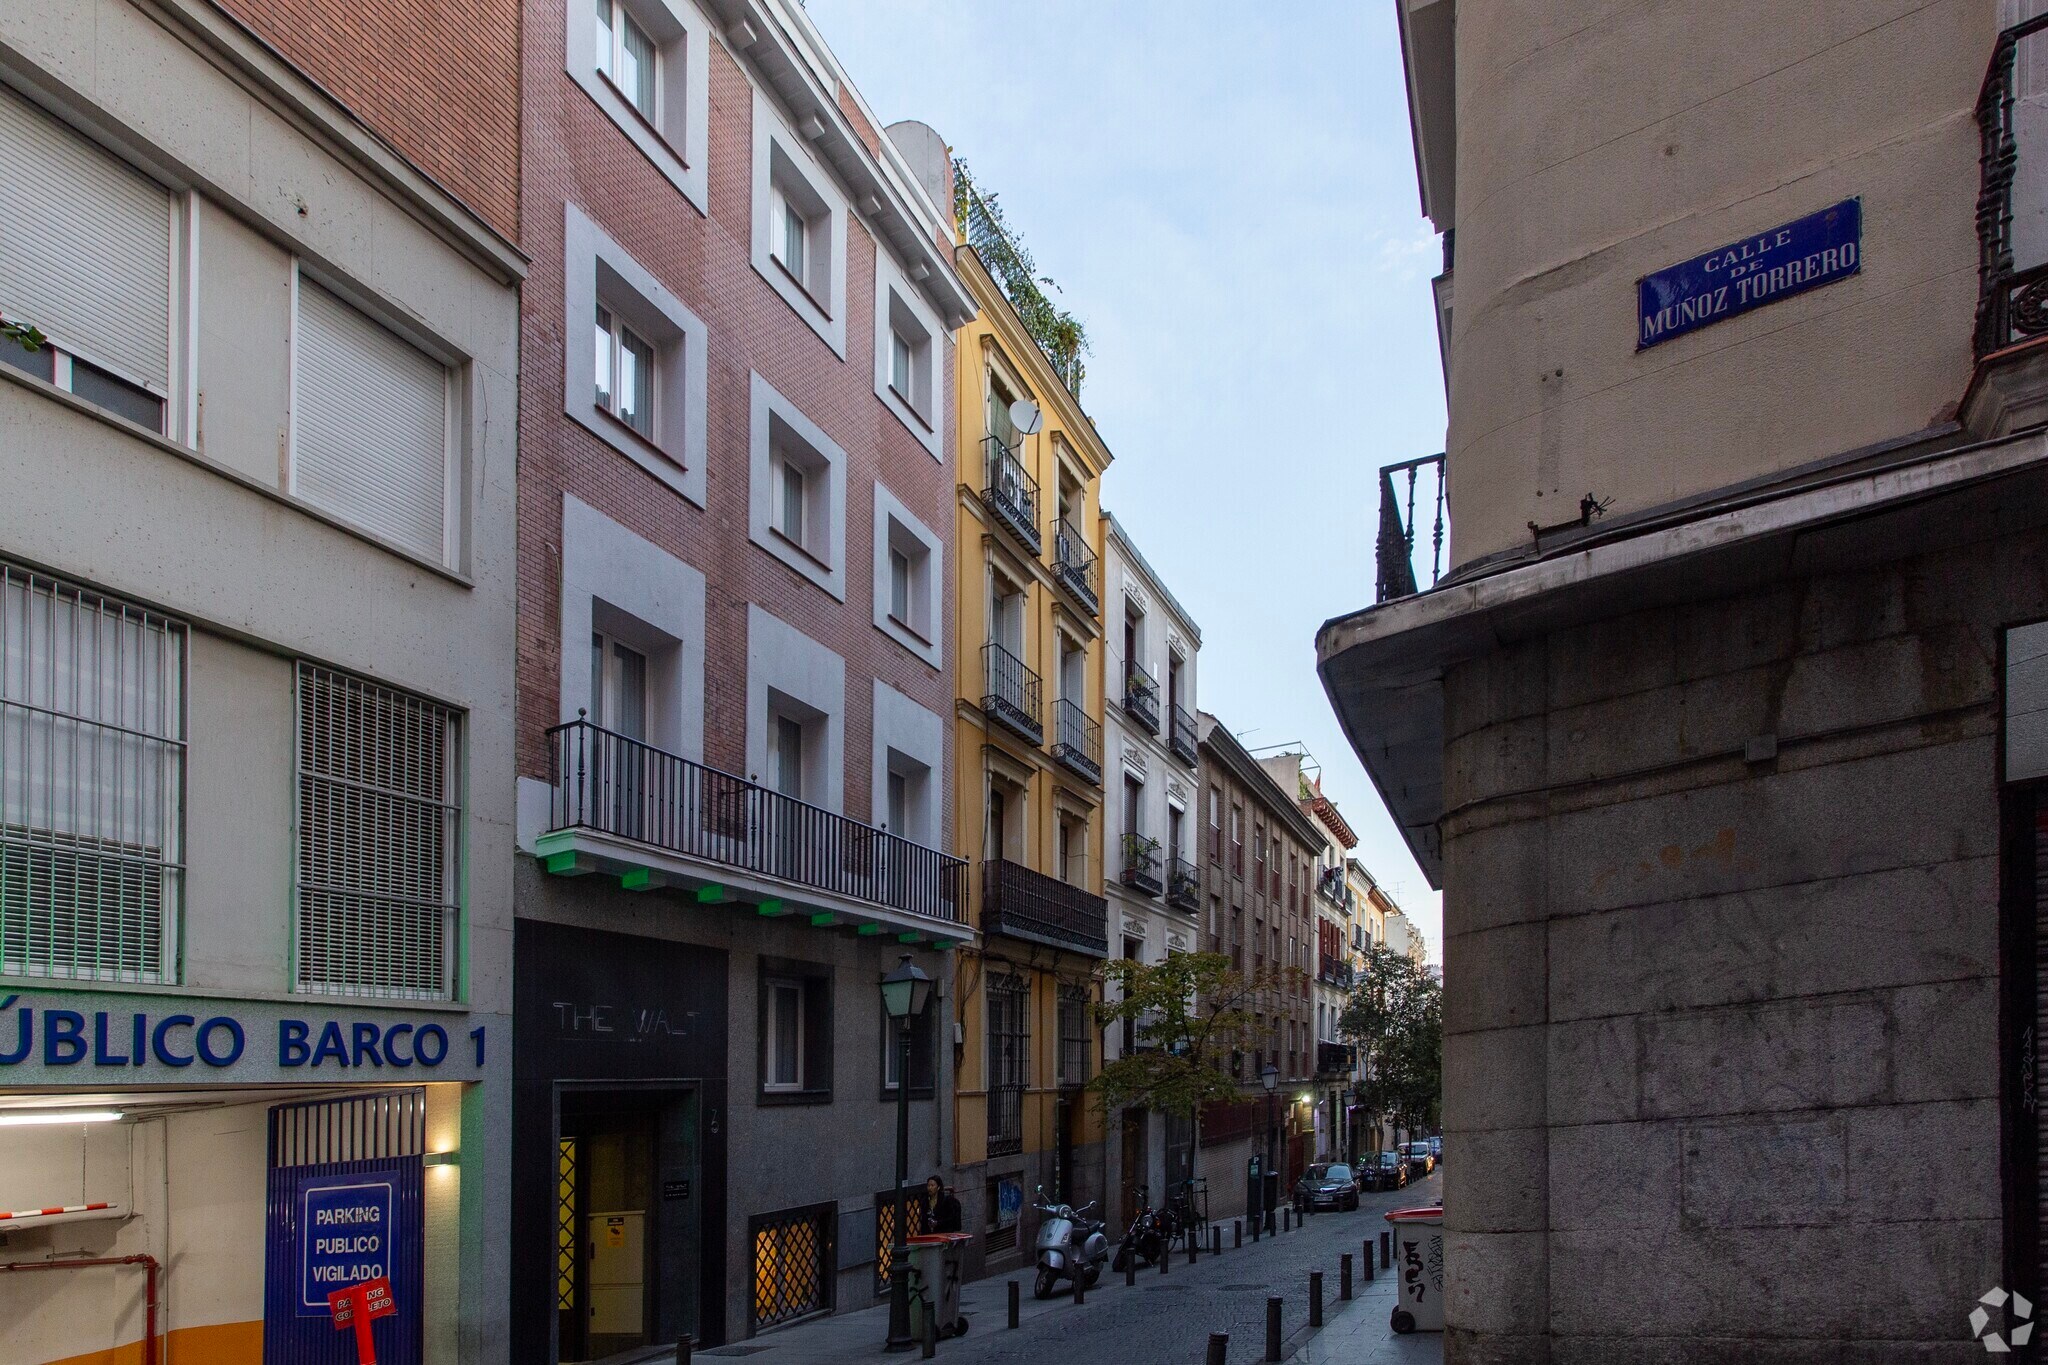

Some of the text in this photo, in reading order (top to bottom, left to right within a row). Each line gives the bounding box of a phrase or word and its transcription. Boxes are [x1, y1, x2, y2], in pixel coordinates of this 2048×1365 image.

[1704, 229, 1790, 273] CALLE
[1730, 258, 1764, 279] DE
[1644, 242, 1856, 339] MUÑOZ TORRERO
[552, 1002, 614, 1032] THE
[279, 1019, 449, 1067] BARCO
[469, 1026, 486, 1067] 1
[316, 1205, 380, 1226] PARKING
[316, 1235, 380, 1255] PUBLICO
[312, 1263, 383, 1282] VIGILADO
[337, 1287, 384, 1309] PANG
